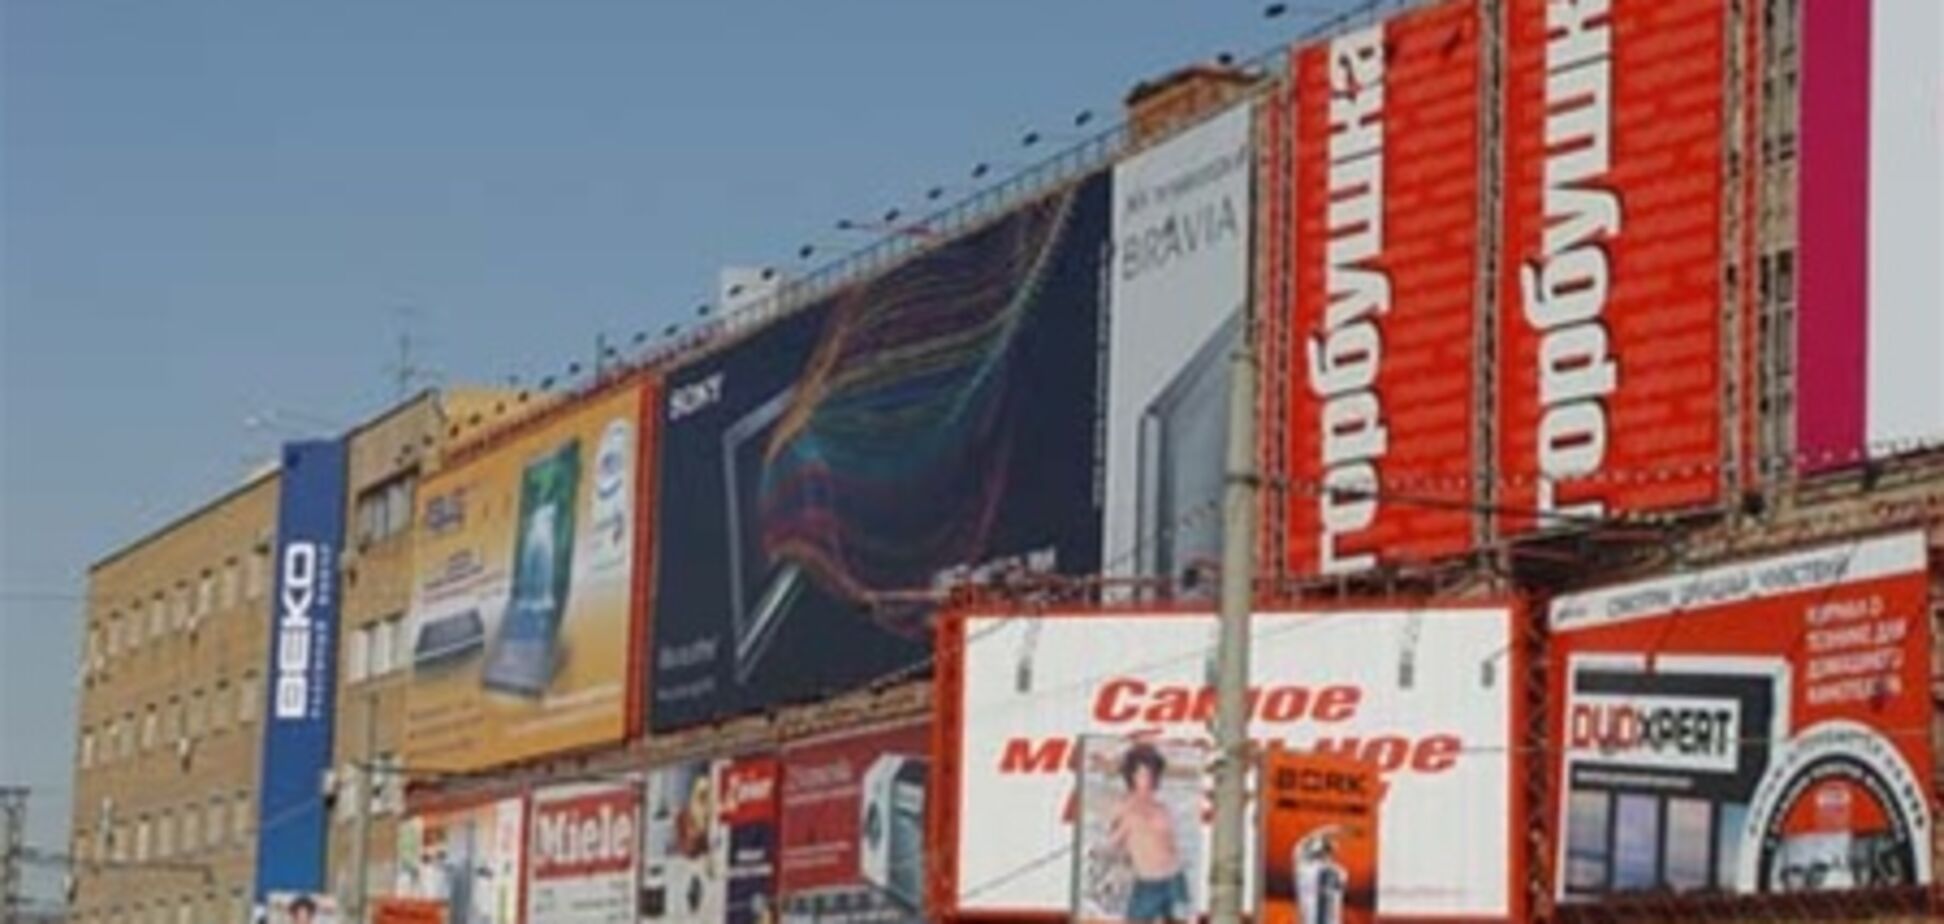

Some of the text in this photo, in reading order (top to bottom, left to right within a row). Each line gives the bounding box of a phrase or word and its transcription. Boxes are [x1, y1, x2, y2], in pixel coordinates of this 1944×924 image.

[276, 543, 316, 718] BEKO
[1277, 766, 1366, 795] BORK
[534, 803, 634, 864] Miele
